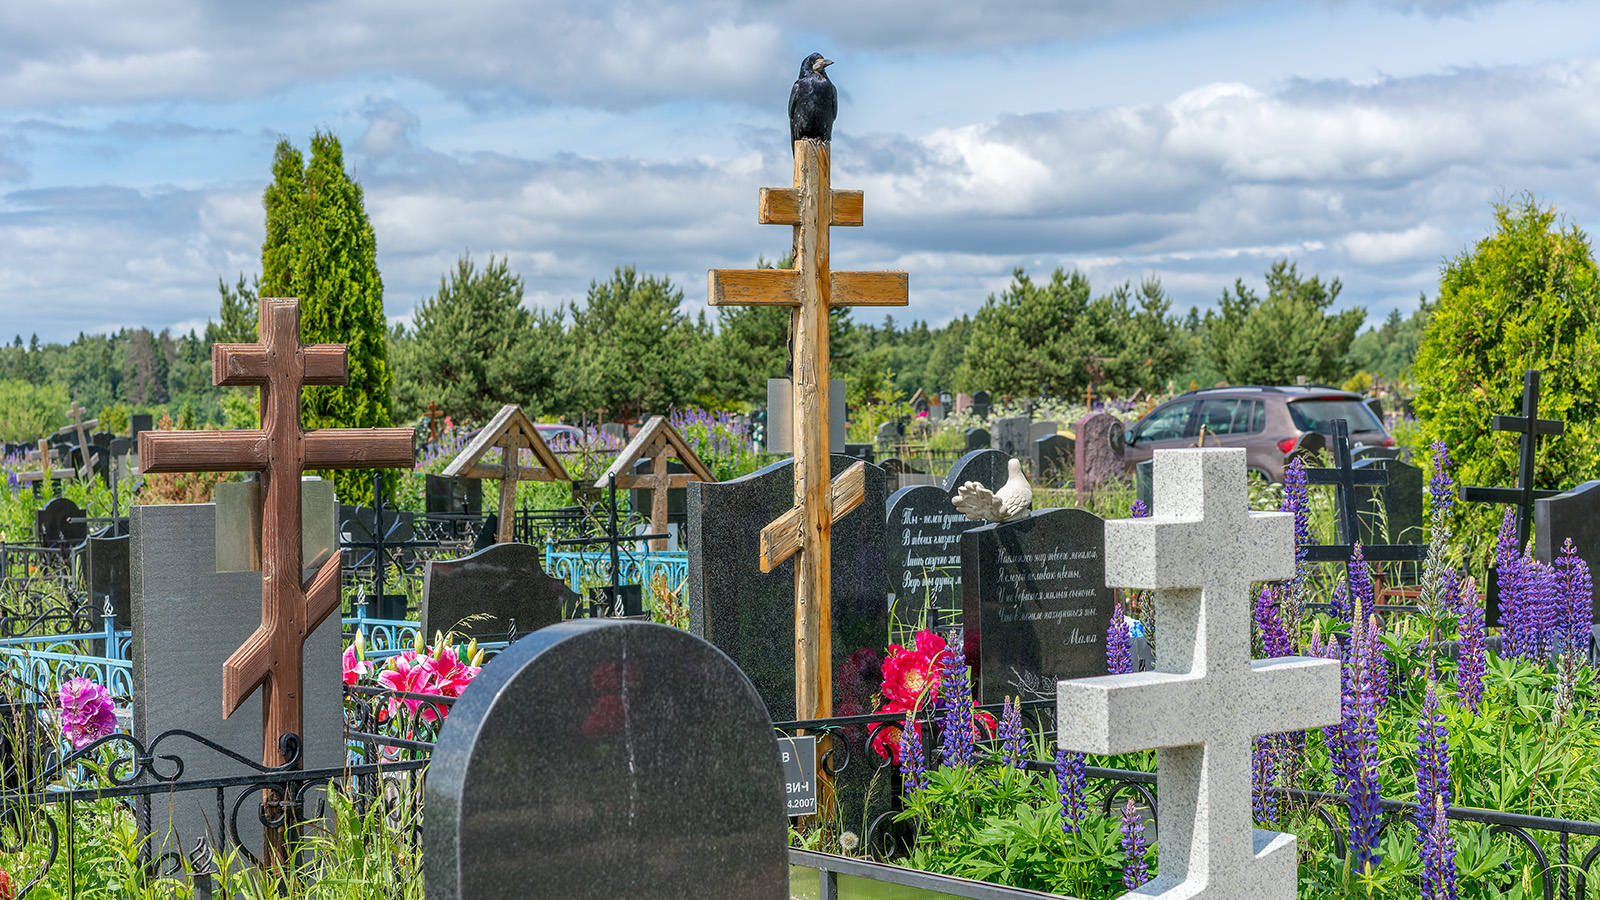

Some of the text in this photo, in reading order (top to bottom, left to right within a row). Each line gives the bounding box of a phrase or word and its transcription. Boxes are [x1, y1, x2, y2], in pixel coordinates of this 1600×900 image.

[901, 507, 918, 525] Ты
[902, 528, 911, 546] В
[911, 530, 932, 545] твоих
[933, 534, 956, 550] глазах
[902, 549, 924, 567] Лишь
[1034, 554, 1046, 567] над
[902, 570, 920, 594] Ведь
[921, 577, 934, 587] ты
[997, 567, 1005, 583] Я
[1005, 569, 1025, 588] слезой
[997, 586, 1005, 603] И
[1006, 594, 1013, 602] не
[999, 607, 1012, 622] Что
[1063, 627, 1097, 646] Мама
